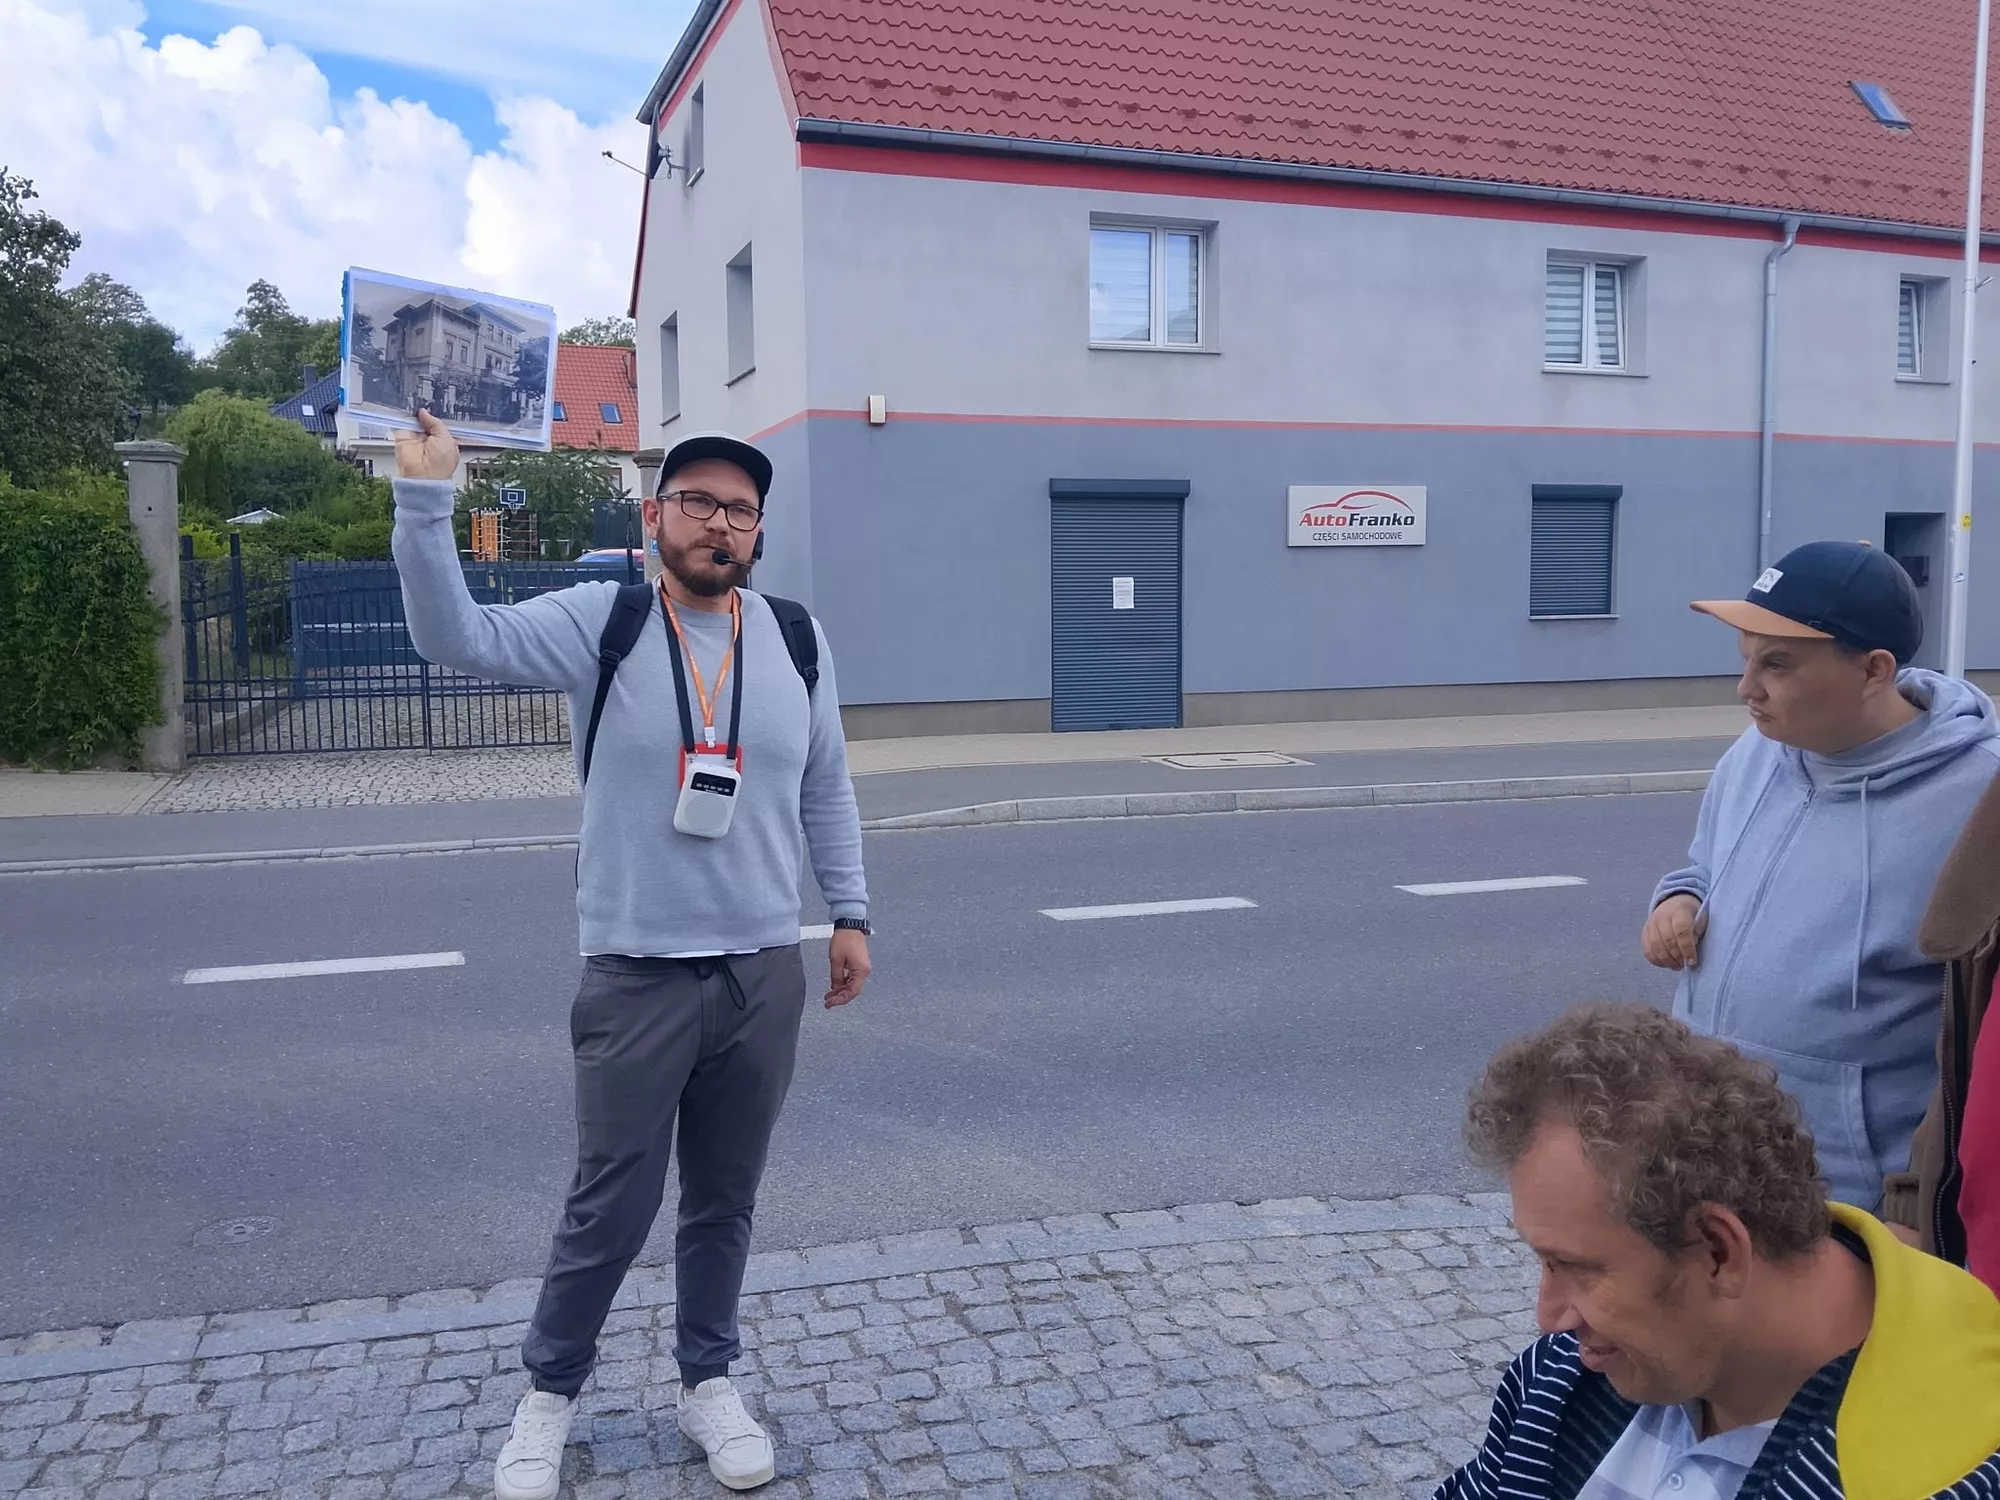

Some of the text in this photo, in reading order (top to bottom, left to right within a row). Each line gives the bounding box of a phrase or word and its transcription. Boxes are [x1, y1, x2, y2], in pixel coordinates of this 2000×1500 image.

[1299, 512, 1415, 526] AutoFranko
[1312, 531, 1402, 541] CZĘŚCI SAMOCHODOWE
